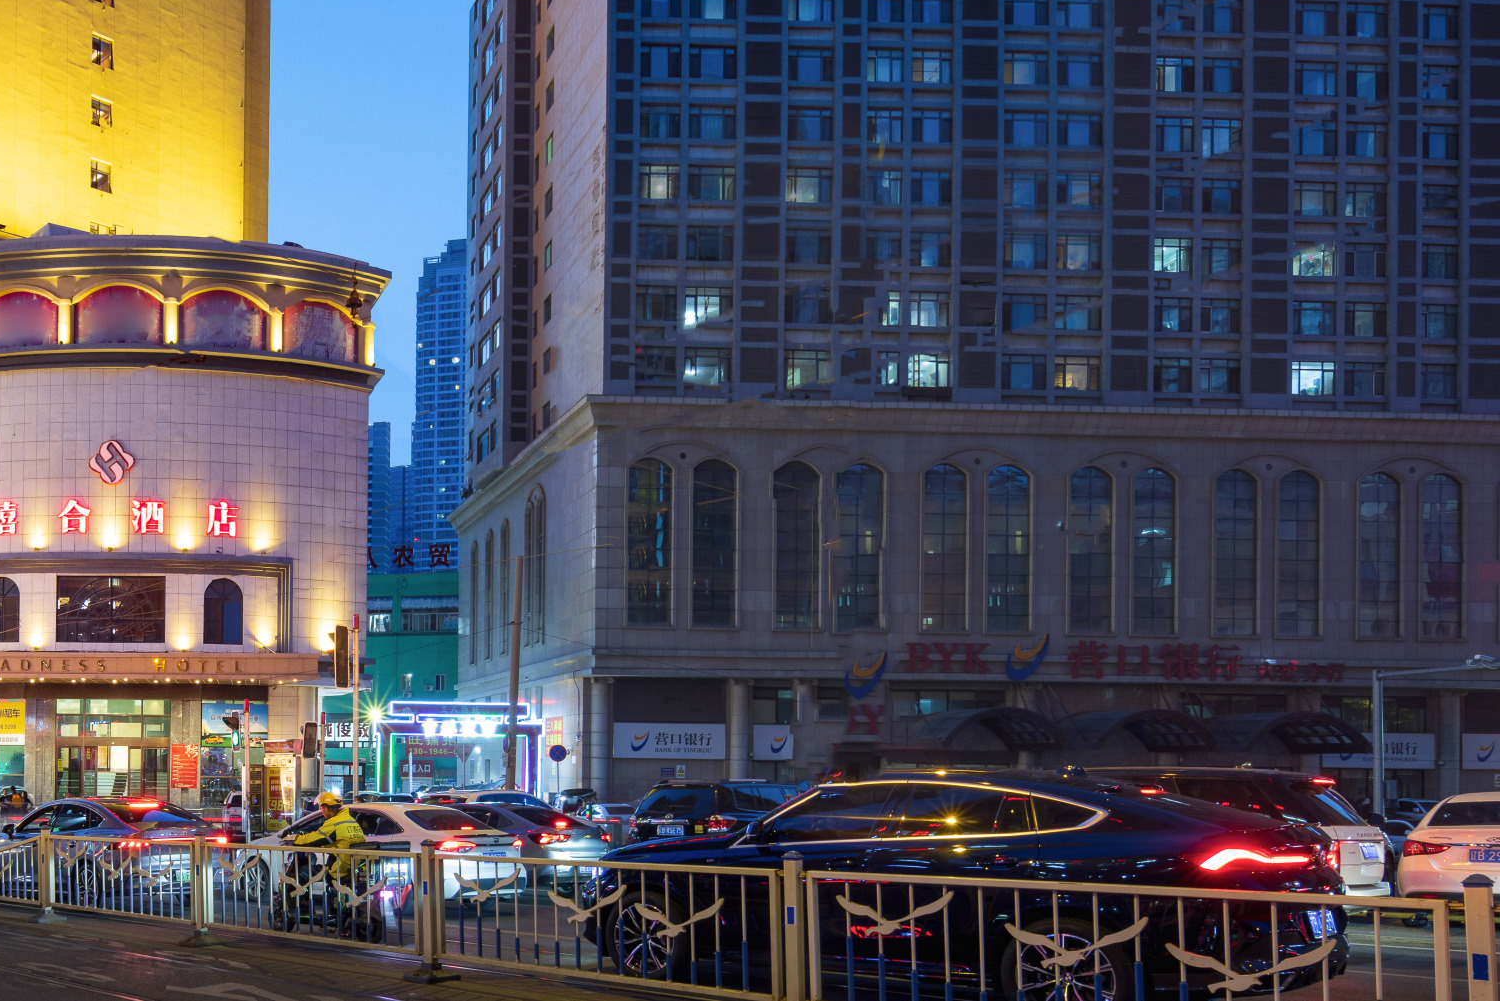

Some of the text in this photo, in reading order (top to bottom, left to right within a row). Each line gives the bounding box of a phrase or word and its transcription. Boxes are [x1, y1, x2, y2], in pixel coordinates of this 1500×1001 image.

[154, 657, 244, 674] HOTEL
[906, 641, 992, 673] BYK
[1067, 640, 1244, 682] 营口银行
[654, 732, 713, 746] 营口银行
[1384, 741, 1419, 755] 银行
